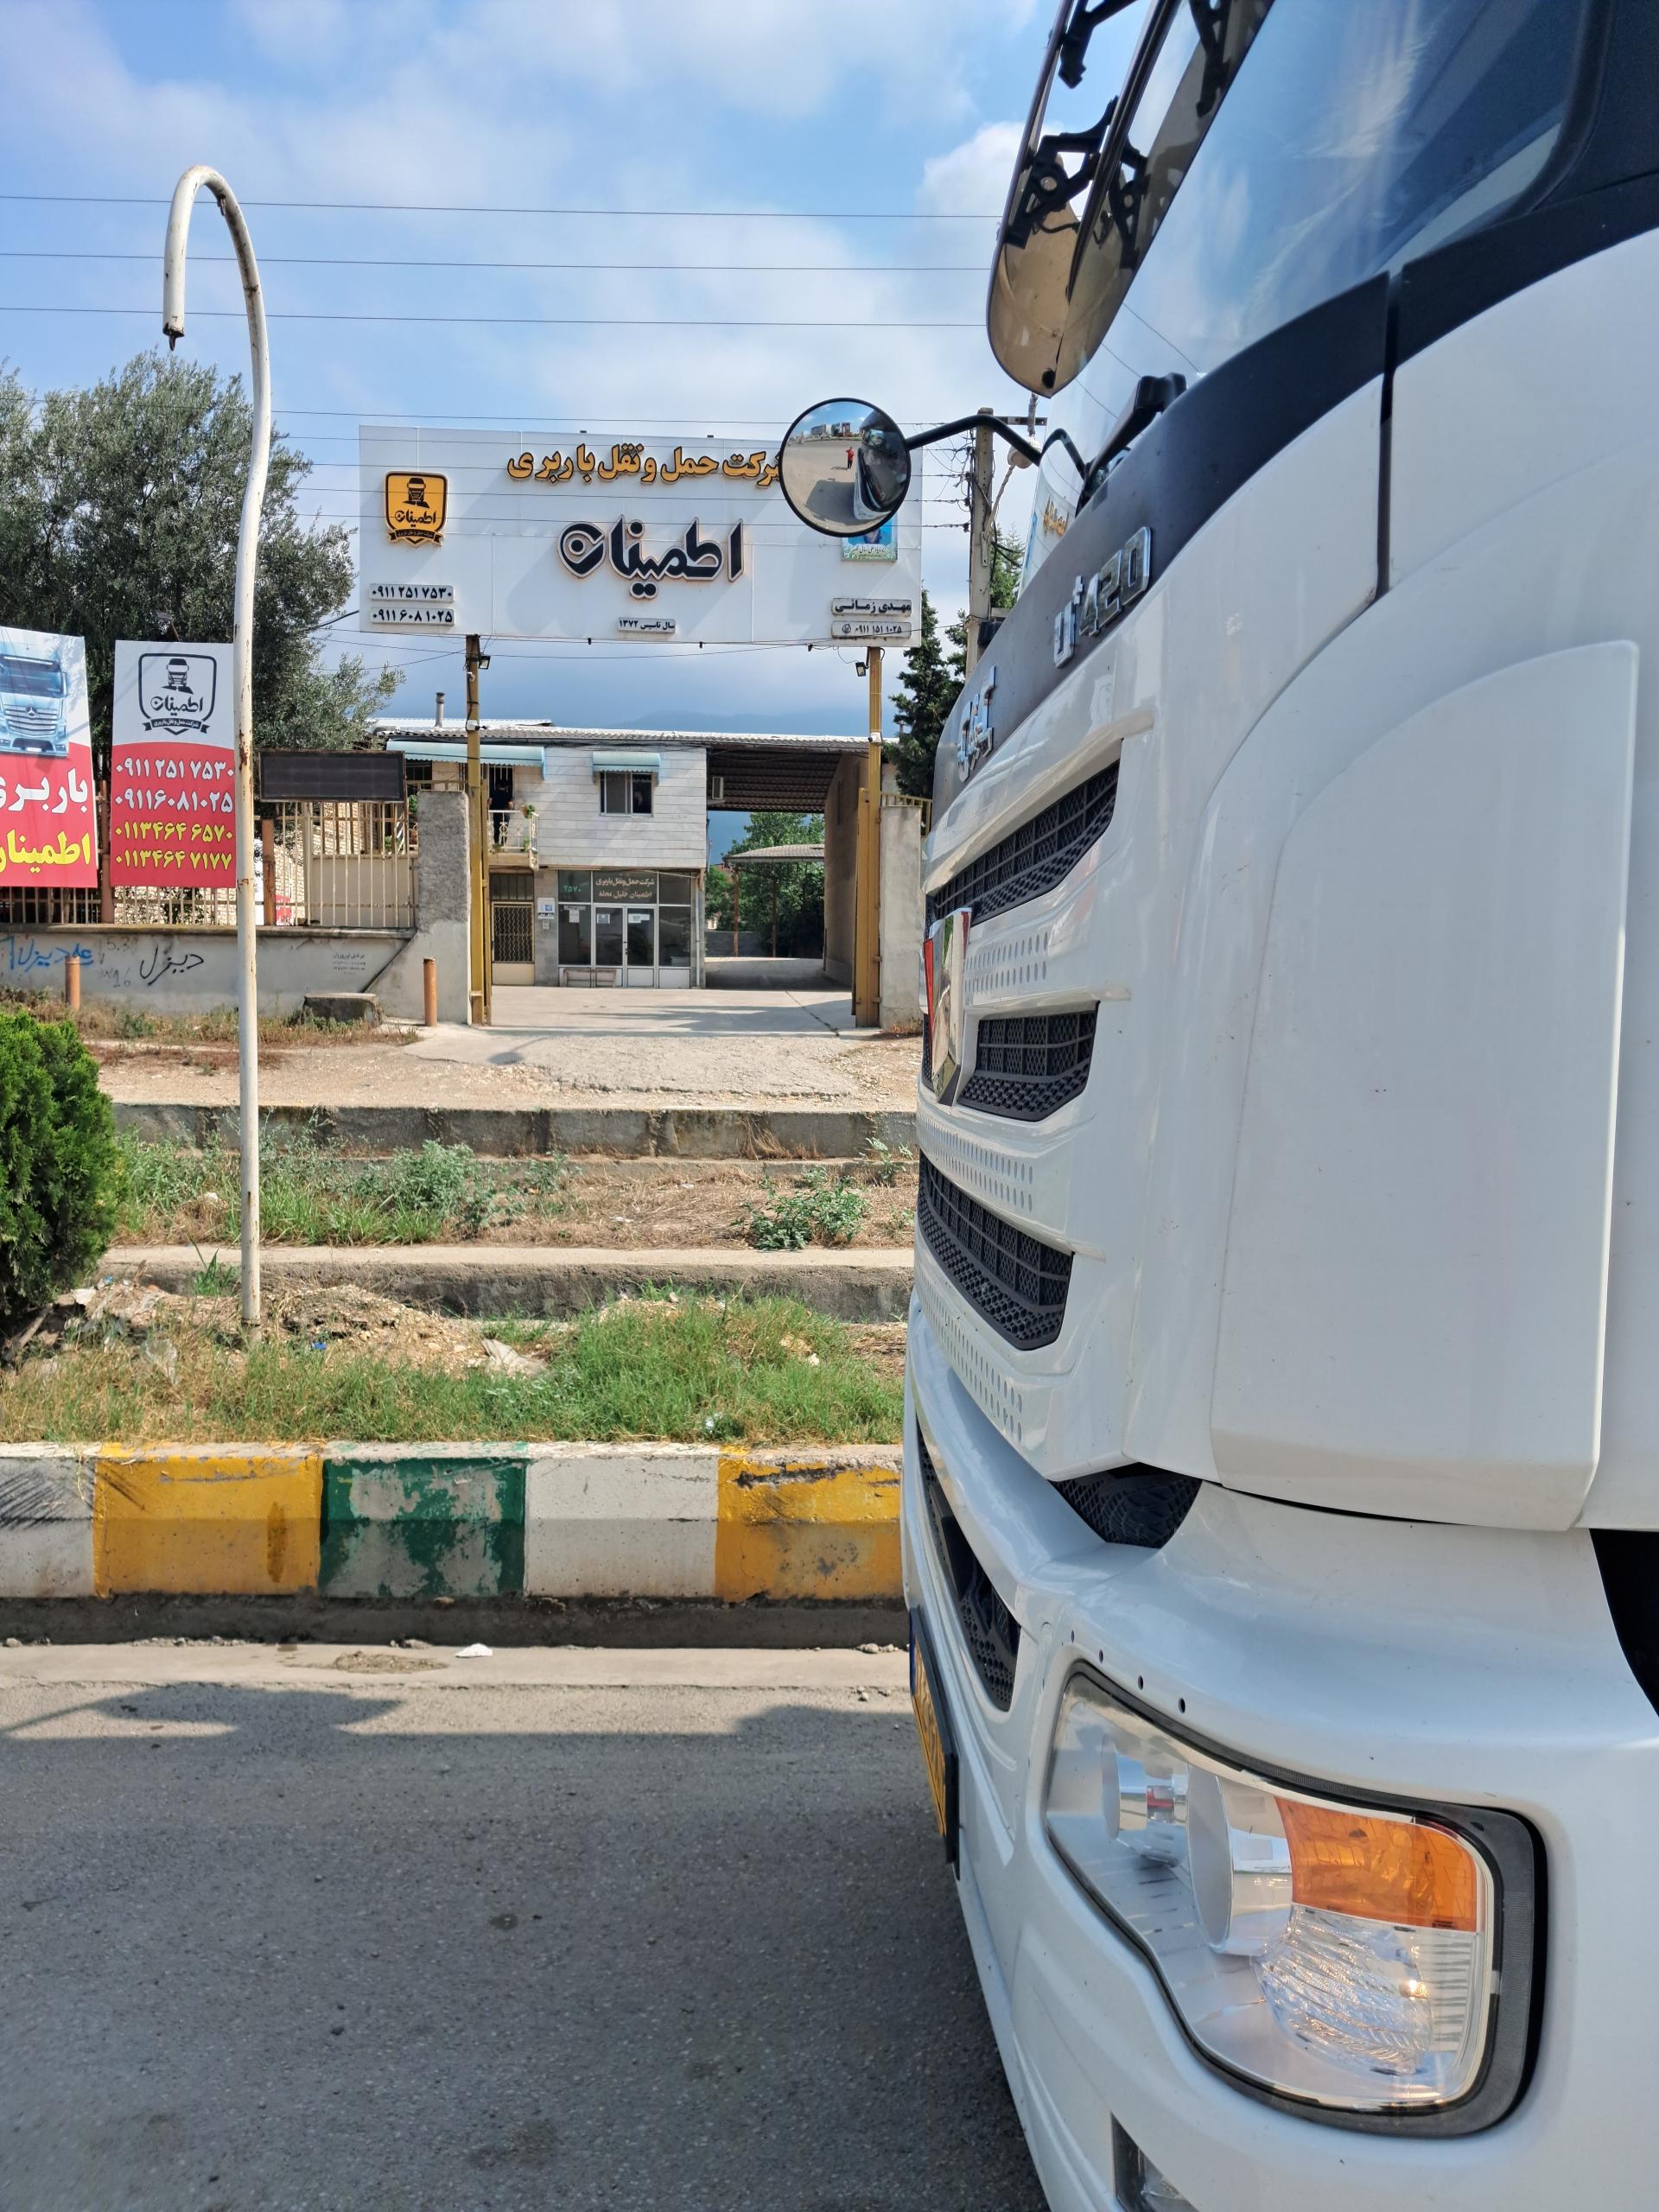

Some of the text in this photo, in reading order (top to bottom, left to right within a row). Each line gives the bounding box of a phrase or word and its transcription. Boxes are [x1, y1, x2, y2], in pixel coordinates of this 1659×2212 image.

[507, 443, 779, 486] رکت حمل و نقل باربری
[395, 509, 435, 527] اطمینان
[557, 514, 744, 599] اطمینان
[372, 585, 452, 599] ۰۹۱۱ ۲۵۱ ۷۵۳۰
[372, 608, 453, 622] ۰۹۱۱ ۶۰۸ ۱۰۲۵
[836, 600, 912, 613] مهدی زمانی
[663, 621, 675, 631] سال
[149, 694, 204, 716] اطمینان
[116, 757, 234, 780] ۰۹۱۱ ۲۵۱ ۷۵۳۰
[0, 767, 88, 814] باربر
[191, 823, 233, 842] ۶۵۷۰
[189, 851, 232, 871] ۷۱۷۷
[140, 944, 205, 987] دیزل
